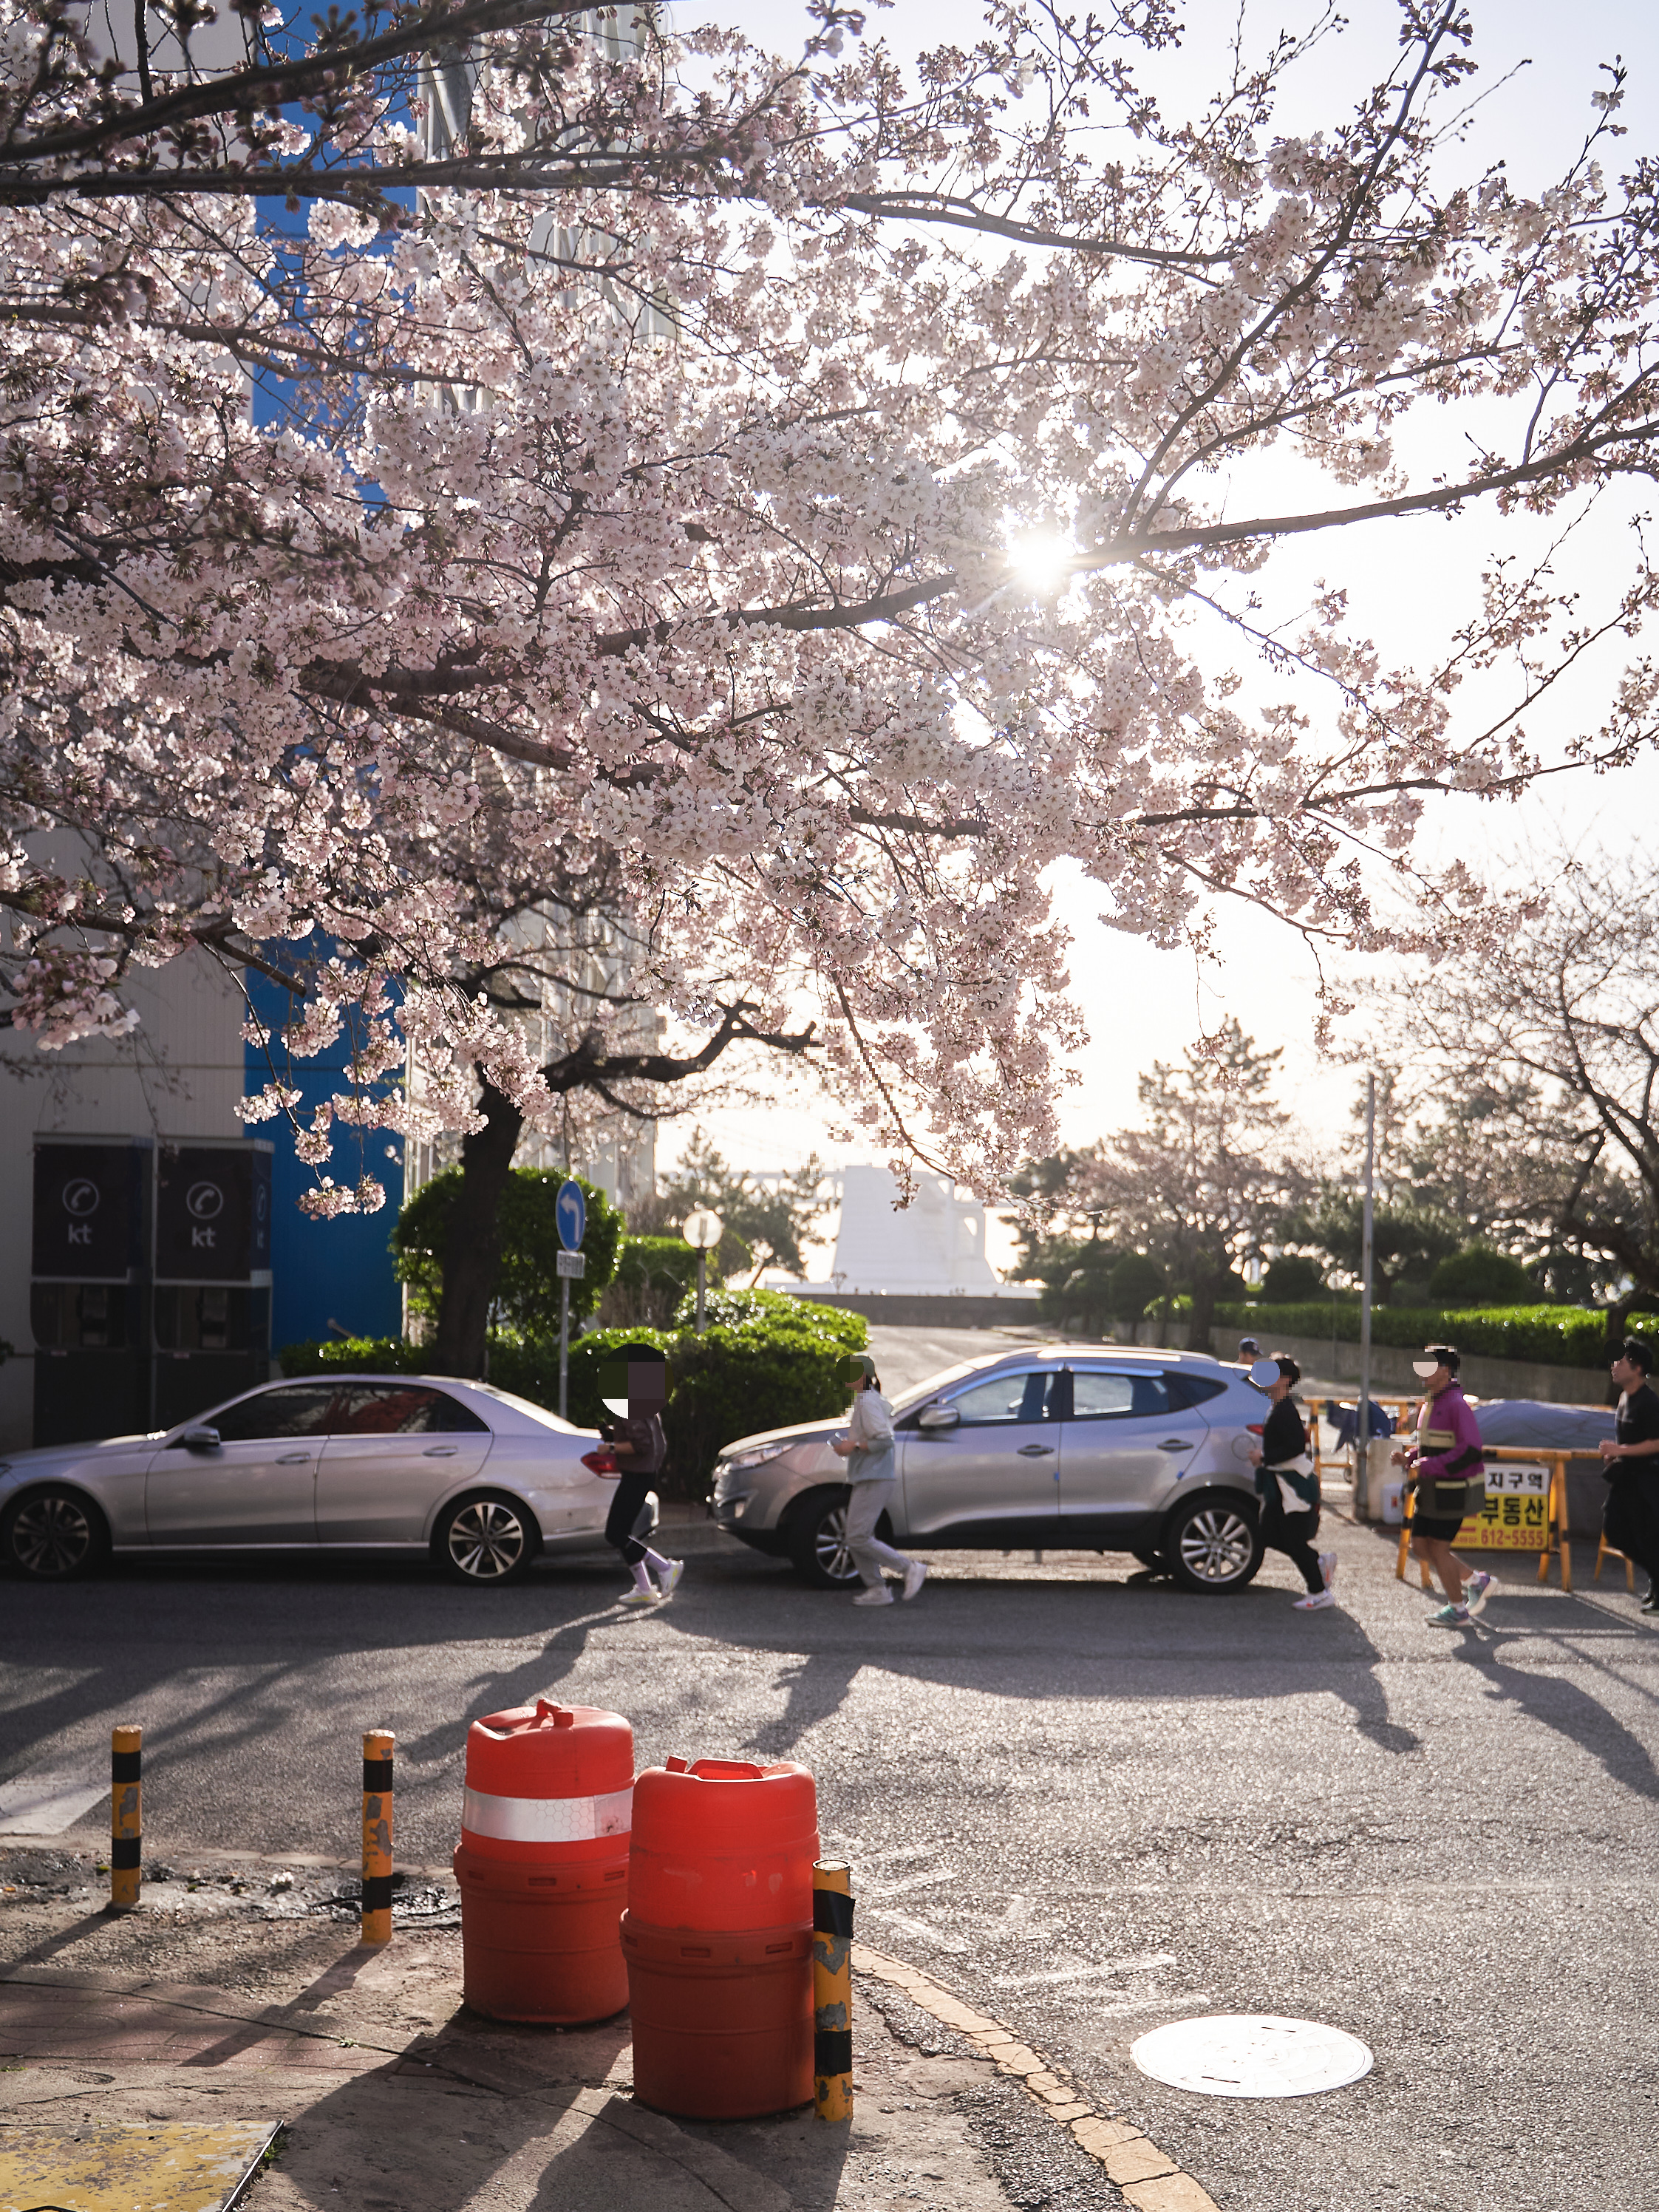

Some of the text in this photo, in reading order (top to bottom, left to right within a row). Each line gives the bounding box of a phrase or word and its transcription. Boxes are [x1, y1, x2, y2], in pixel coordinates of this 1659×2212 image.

[67, 1223, 92, 1245] kt
[191, 1226, 217, 1248] kt
[1481, 1497, 1544, 1526] 부동산
[1481, 1529, 1544, 1546] 612-5555
